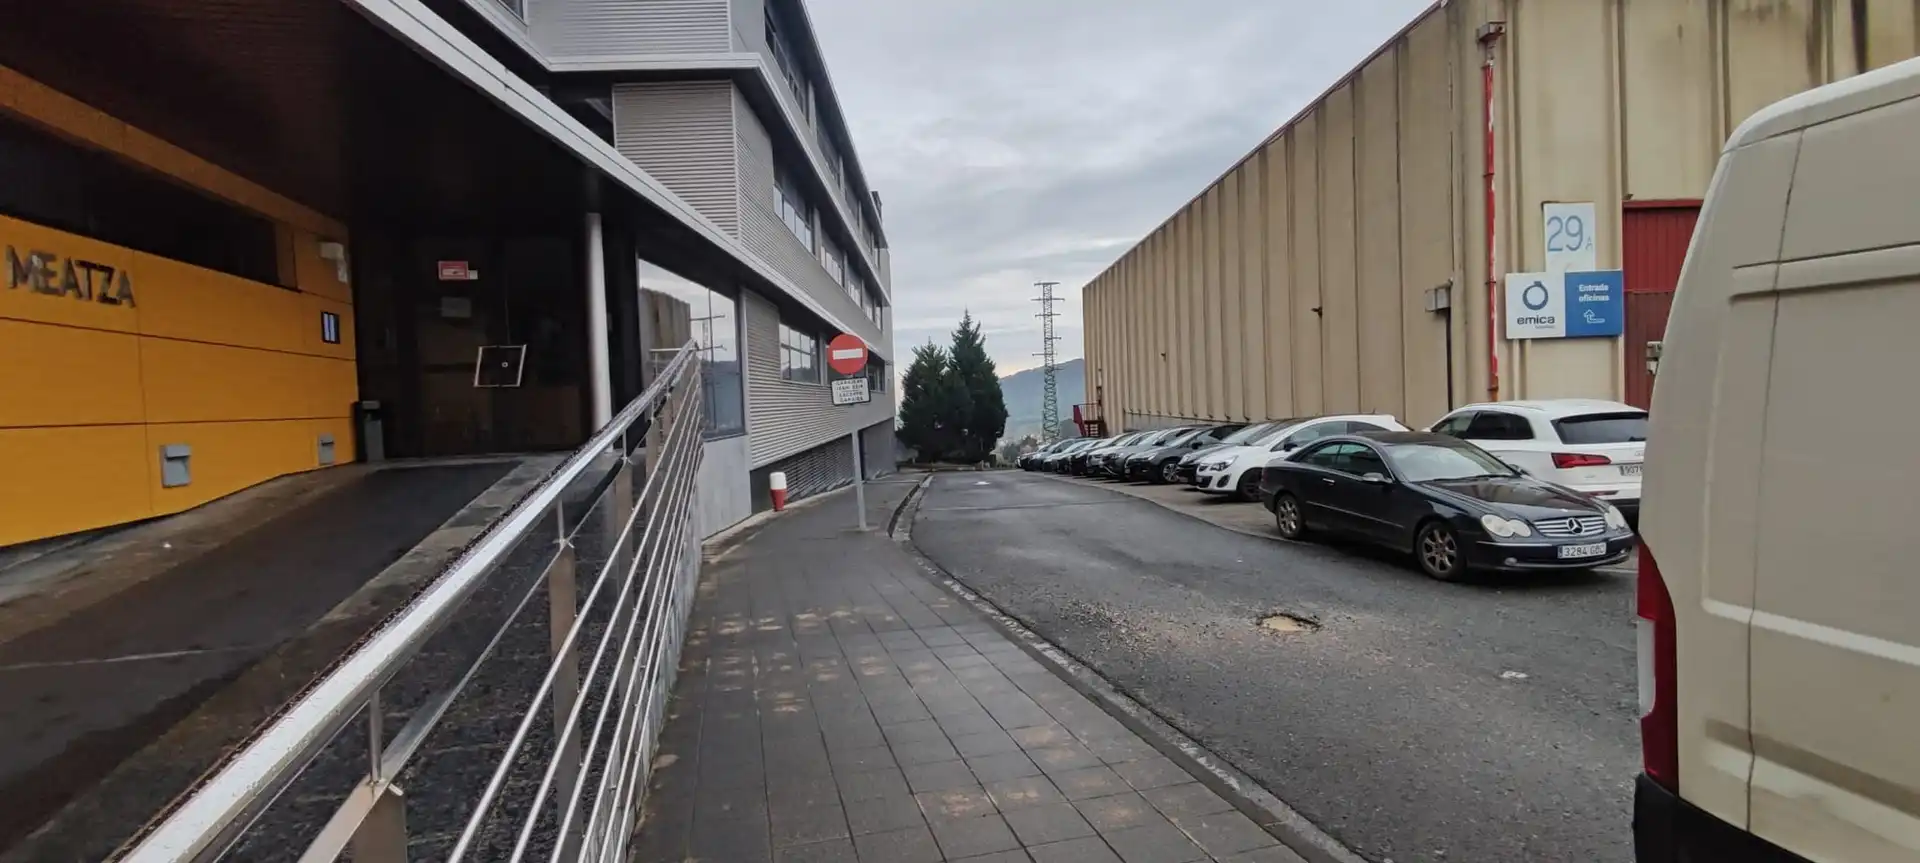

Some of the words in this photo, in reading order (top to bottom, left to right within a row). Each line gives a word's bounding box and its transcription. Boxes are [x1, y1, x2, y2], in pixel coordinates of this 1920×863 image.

[5, 245, 137, 308] MEATZA
[1579, 283, 1609, 292] Entrada
[1579, 293, 1610, 302] oficinas
[1517, 315, 1555, 325] emica
[1564, 546, 1588, 557] 3284
